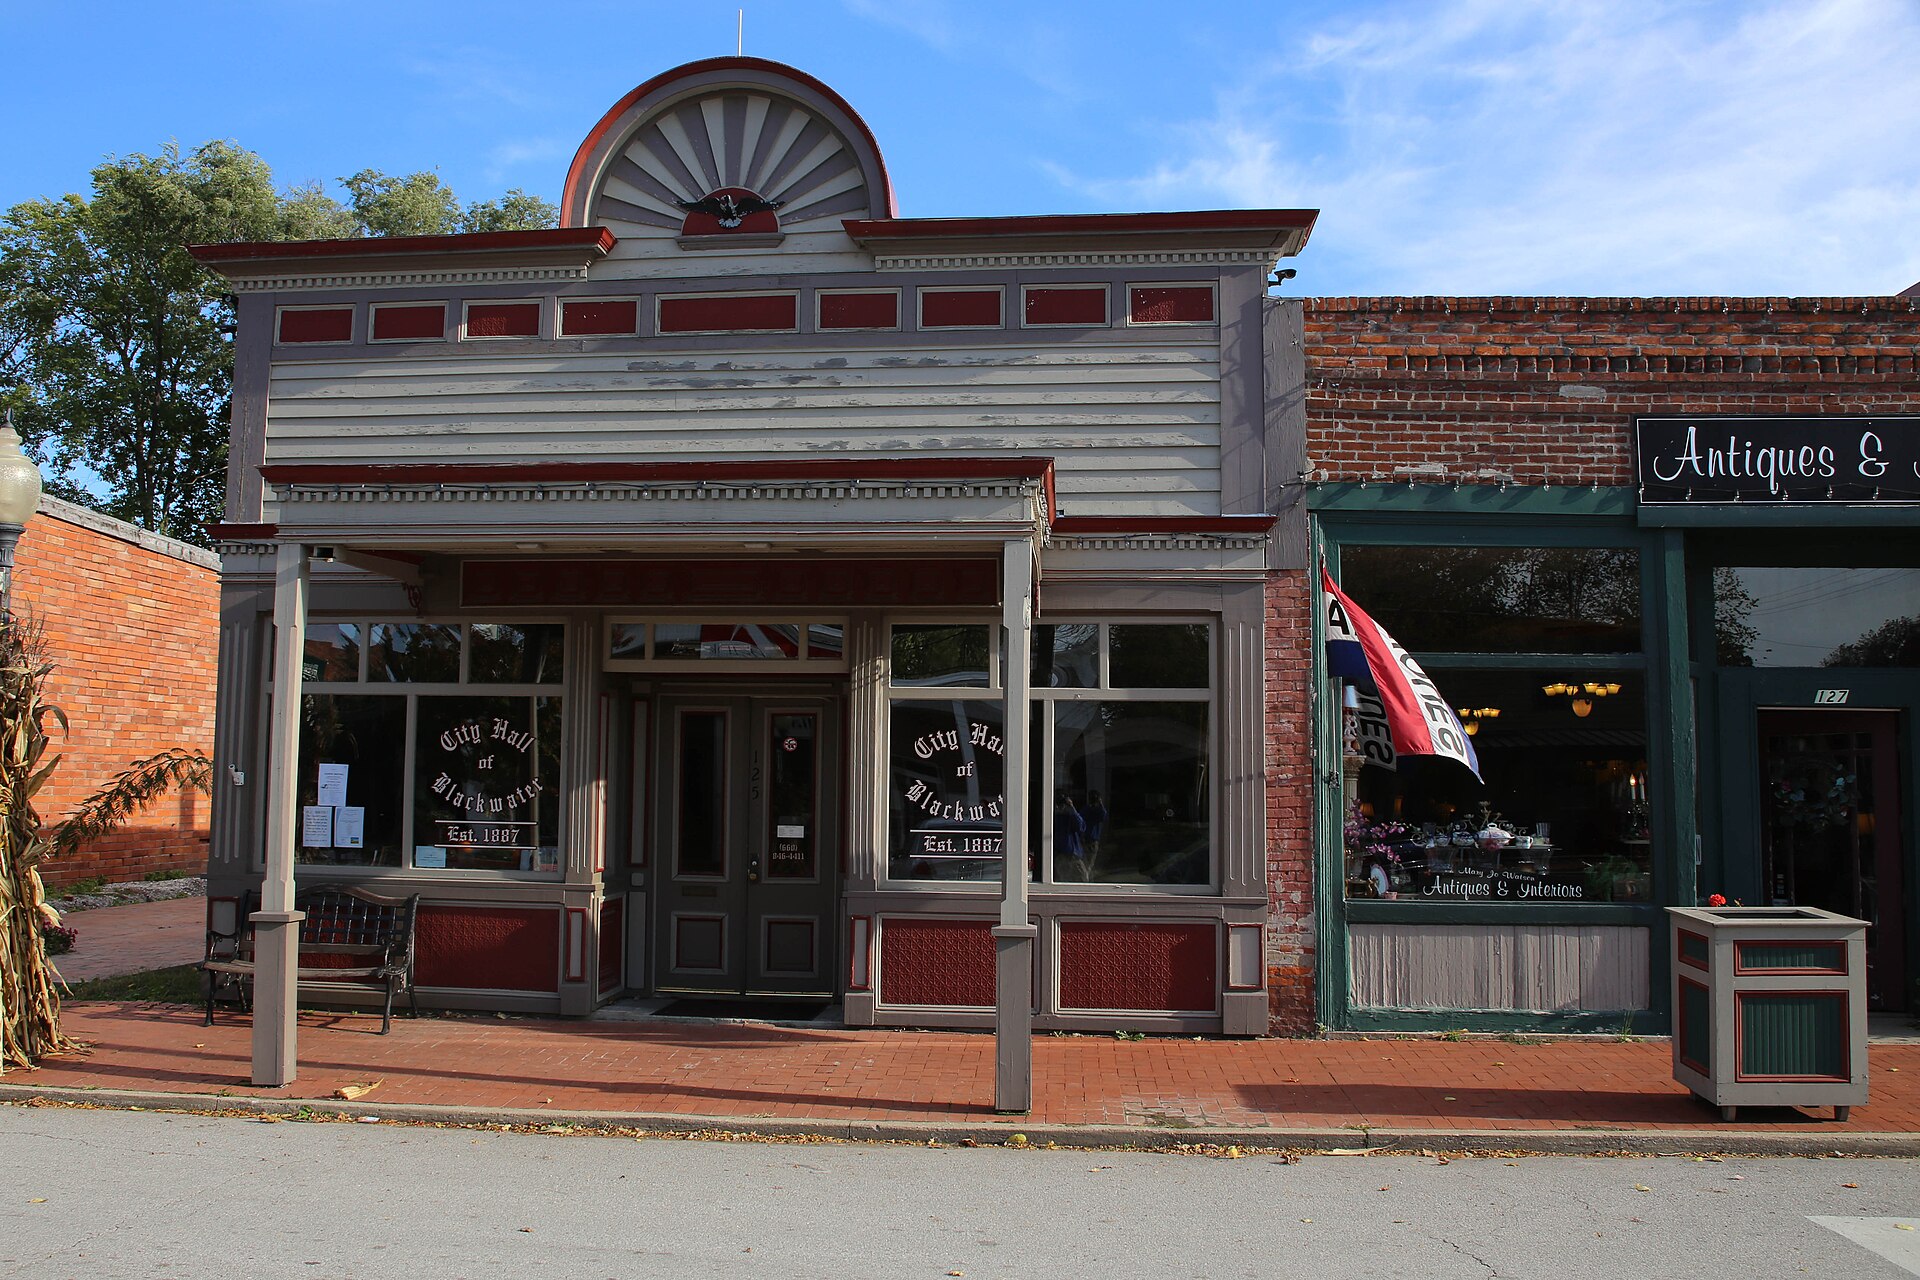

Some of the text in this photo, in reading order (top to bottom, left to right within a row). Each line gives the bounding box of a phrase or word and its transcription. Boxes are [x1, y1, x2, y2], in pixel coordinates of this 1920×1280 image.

[1653, 426, 1835, 495] Antiques
[1858, 431, 1889, 477] &
[1819, 691, 1847, 702] 127
[440, 718, 536, 753] City Hall
[914, 729, 959, 759] City
[478, 754, 495, 769] of
[956, 761, 974, 777] of
[431, 772, 544, 813] Blackwater
[447, 826, 520, 843] Est. 1887
[923, 835, 1003, 853] Est. 1887
[1458, 866, 1484, 878] Mary
[1486, 869, 1499, 879] Jo
[1422, 875, 1490, 901] Antiques
[1497, 880, 1509, 897] &
